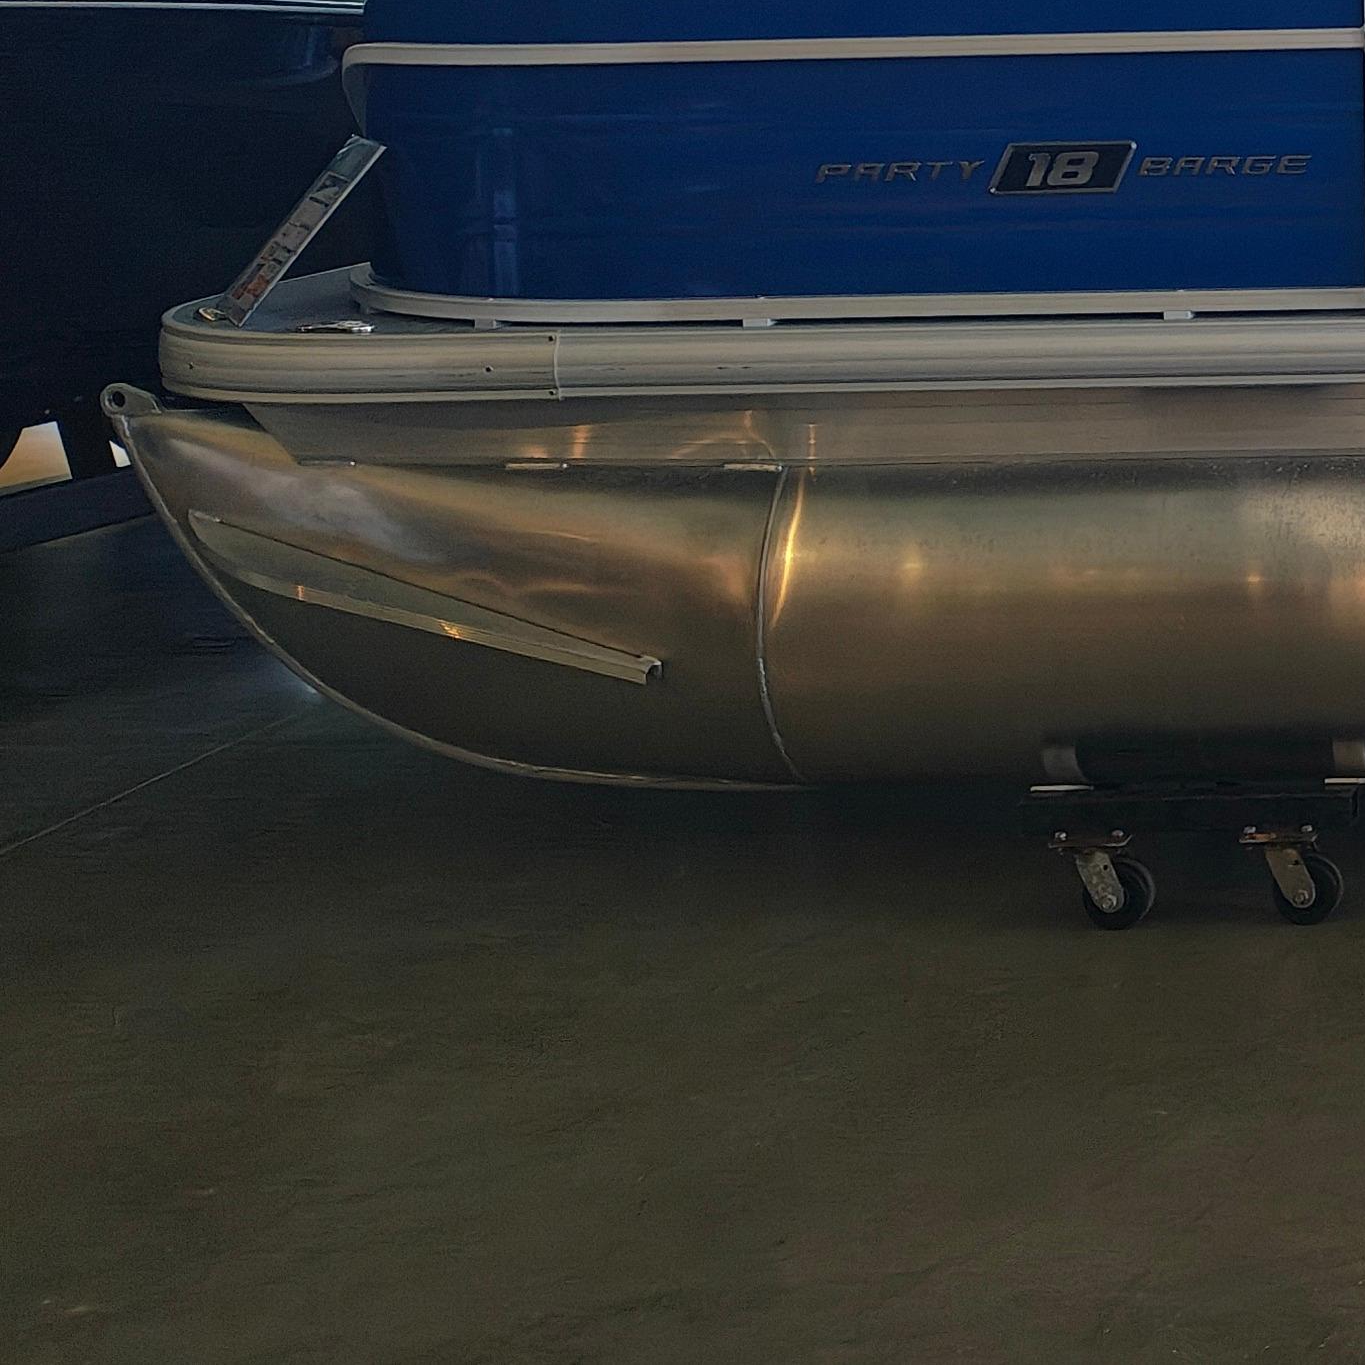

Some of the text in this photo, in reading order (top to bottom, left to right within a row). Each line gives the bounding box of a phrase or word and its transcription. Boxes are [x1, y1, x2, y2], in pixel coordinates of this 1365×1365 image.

[815, 151, 1312, 188] PARTY 18 BARGE
